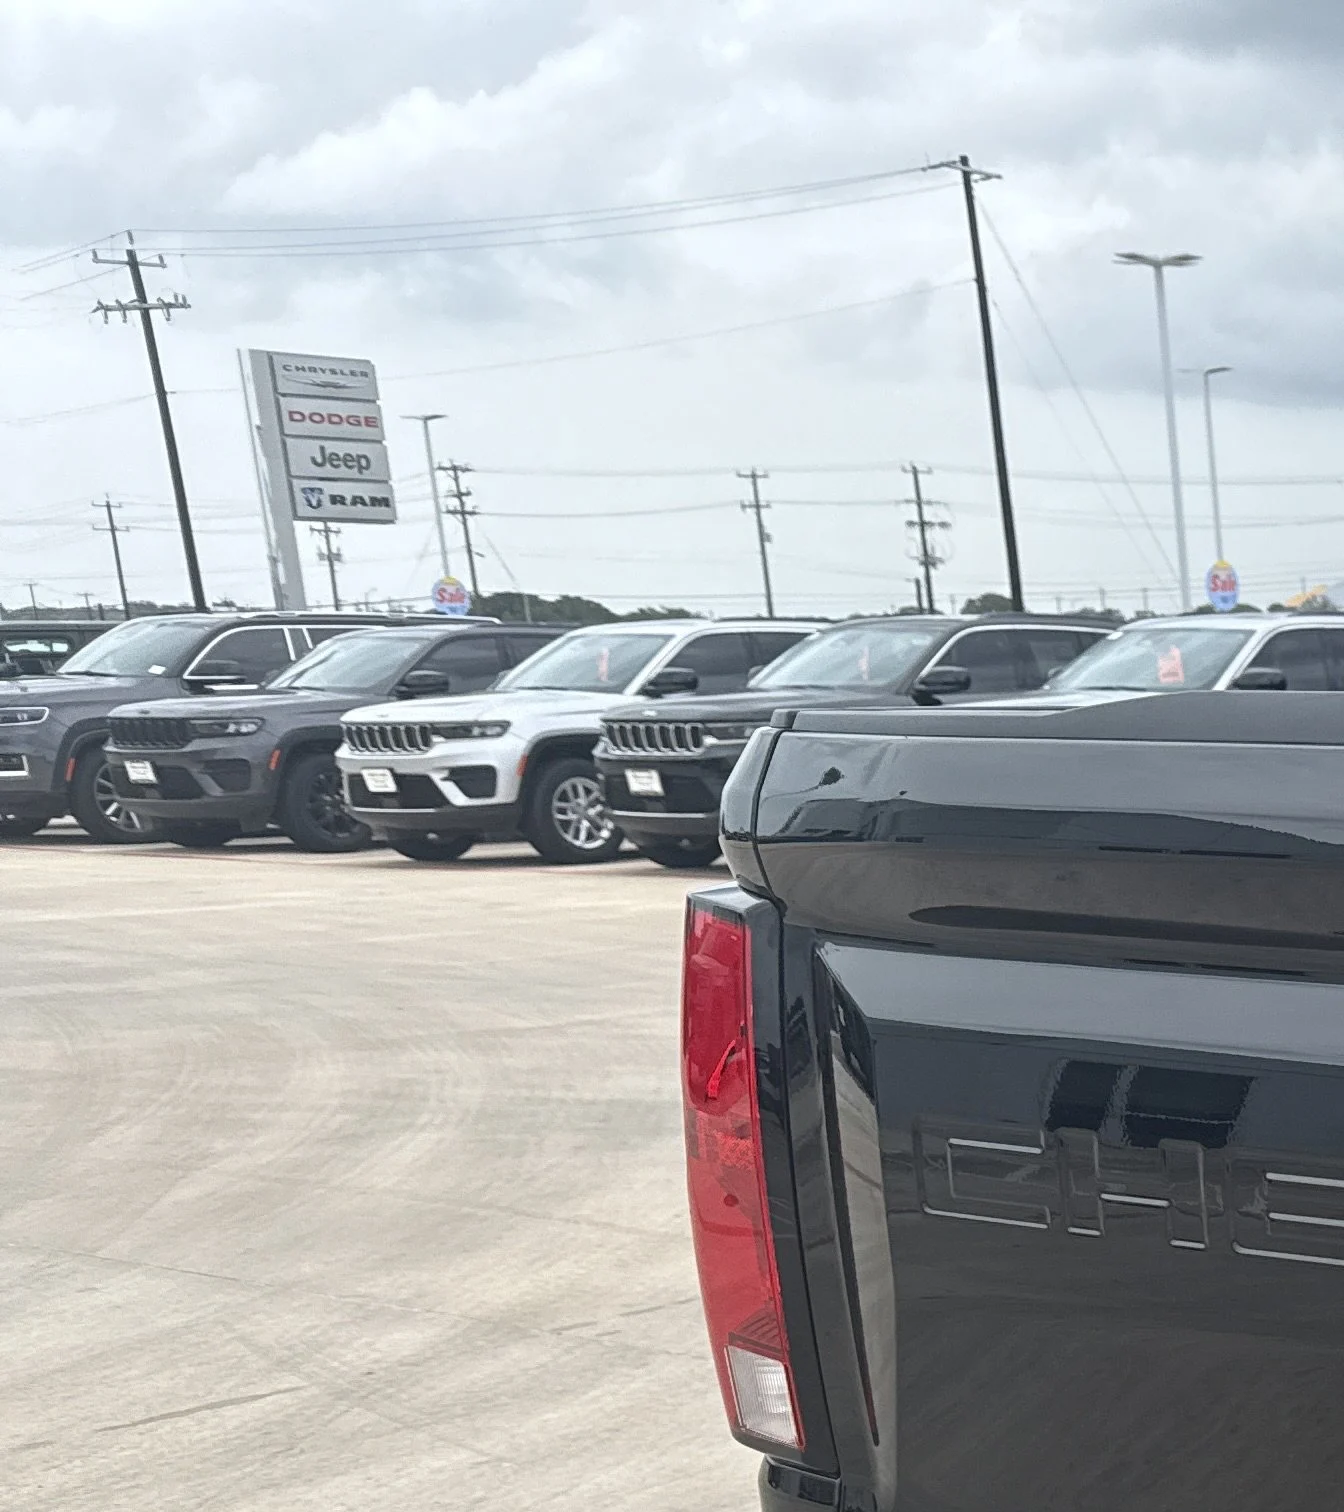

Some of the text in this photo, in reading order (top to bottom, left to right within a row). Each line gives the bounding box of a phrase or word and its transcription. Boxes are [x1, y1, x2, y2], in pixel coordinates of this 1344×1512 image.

[282, 364, 369, 378] CHRYSLER
[287, 410, 379, 428] DODGE
[310, 444, 372, 474] Jeep
[328, 494, 392, 508] RAM
